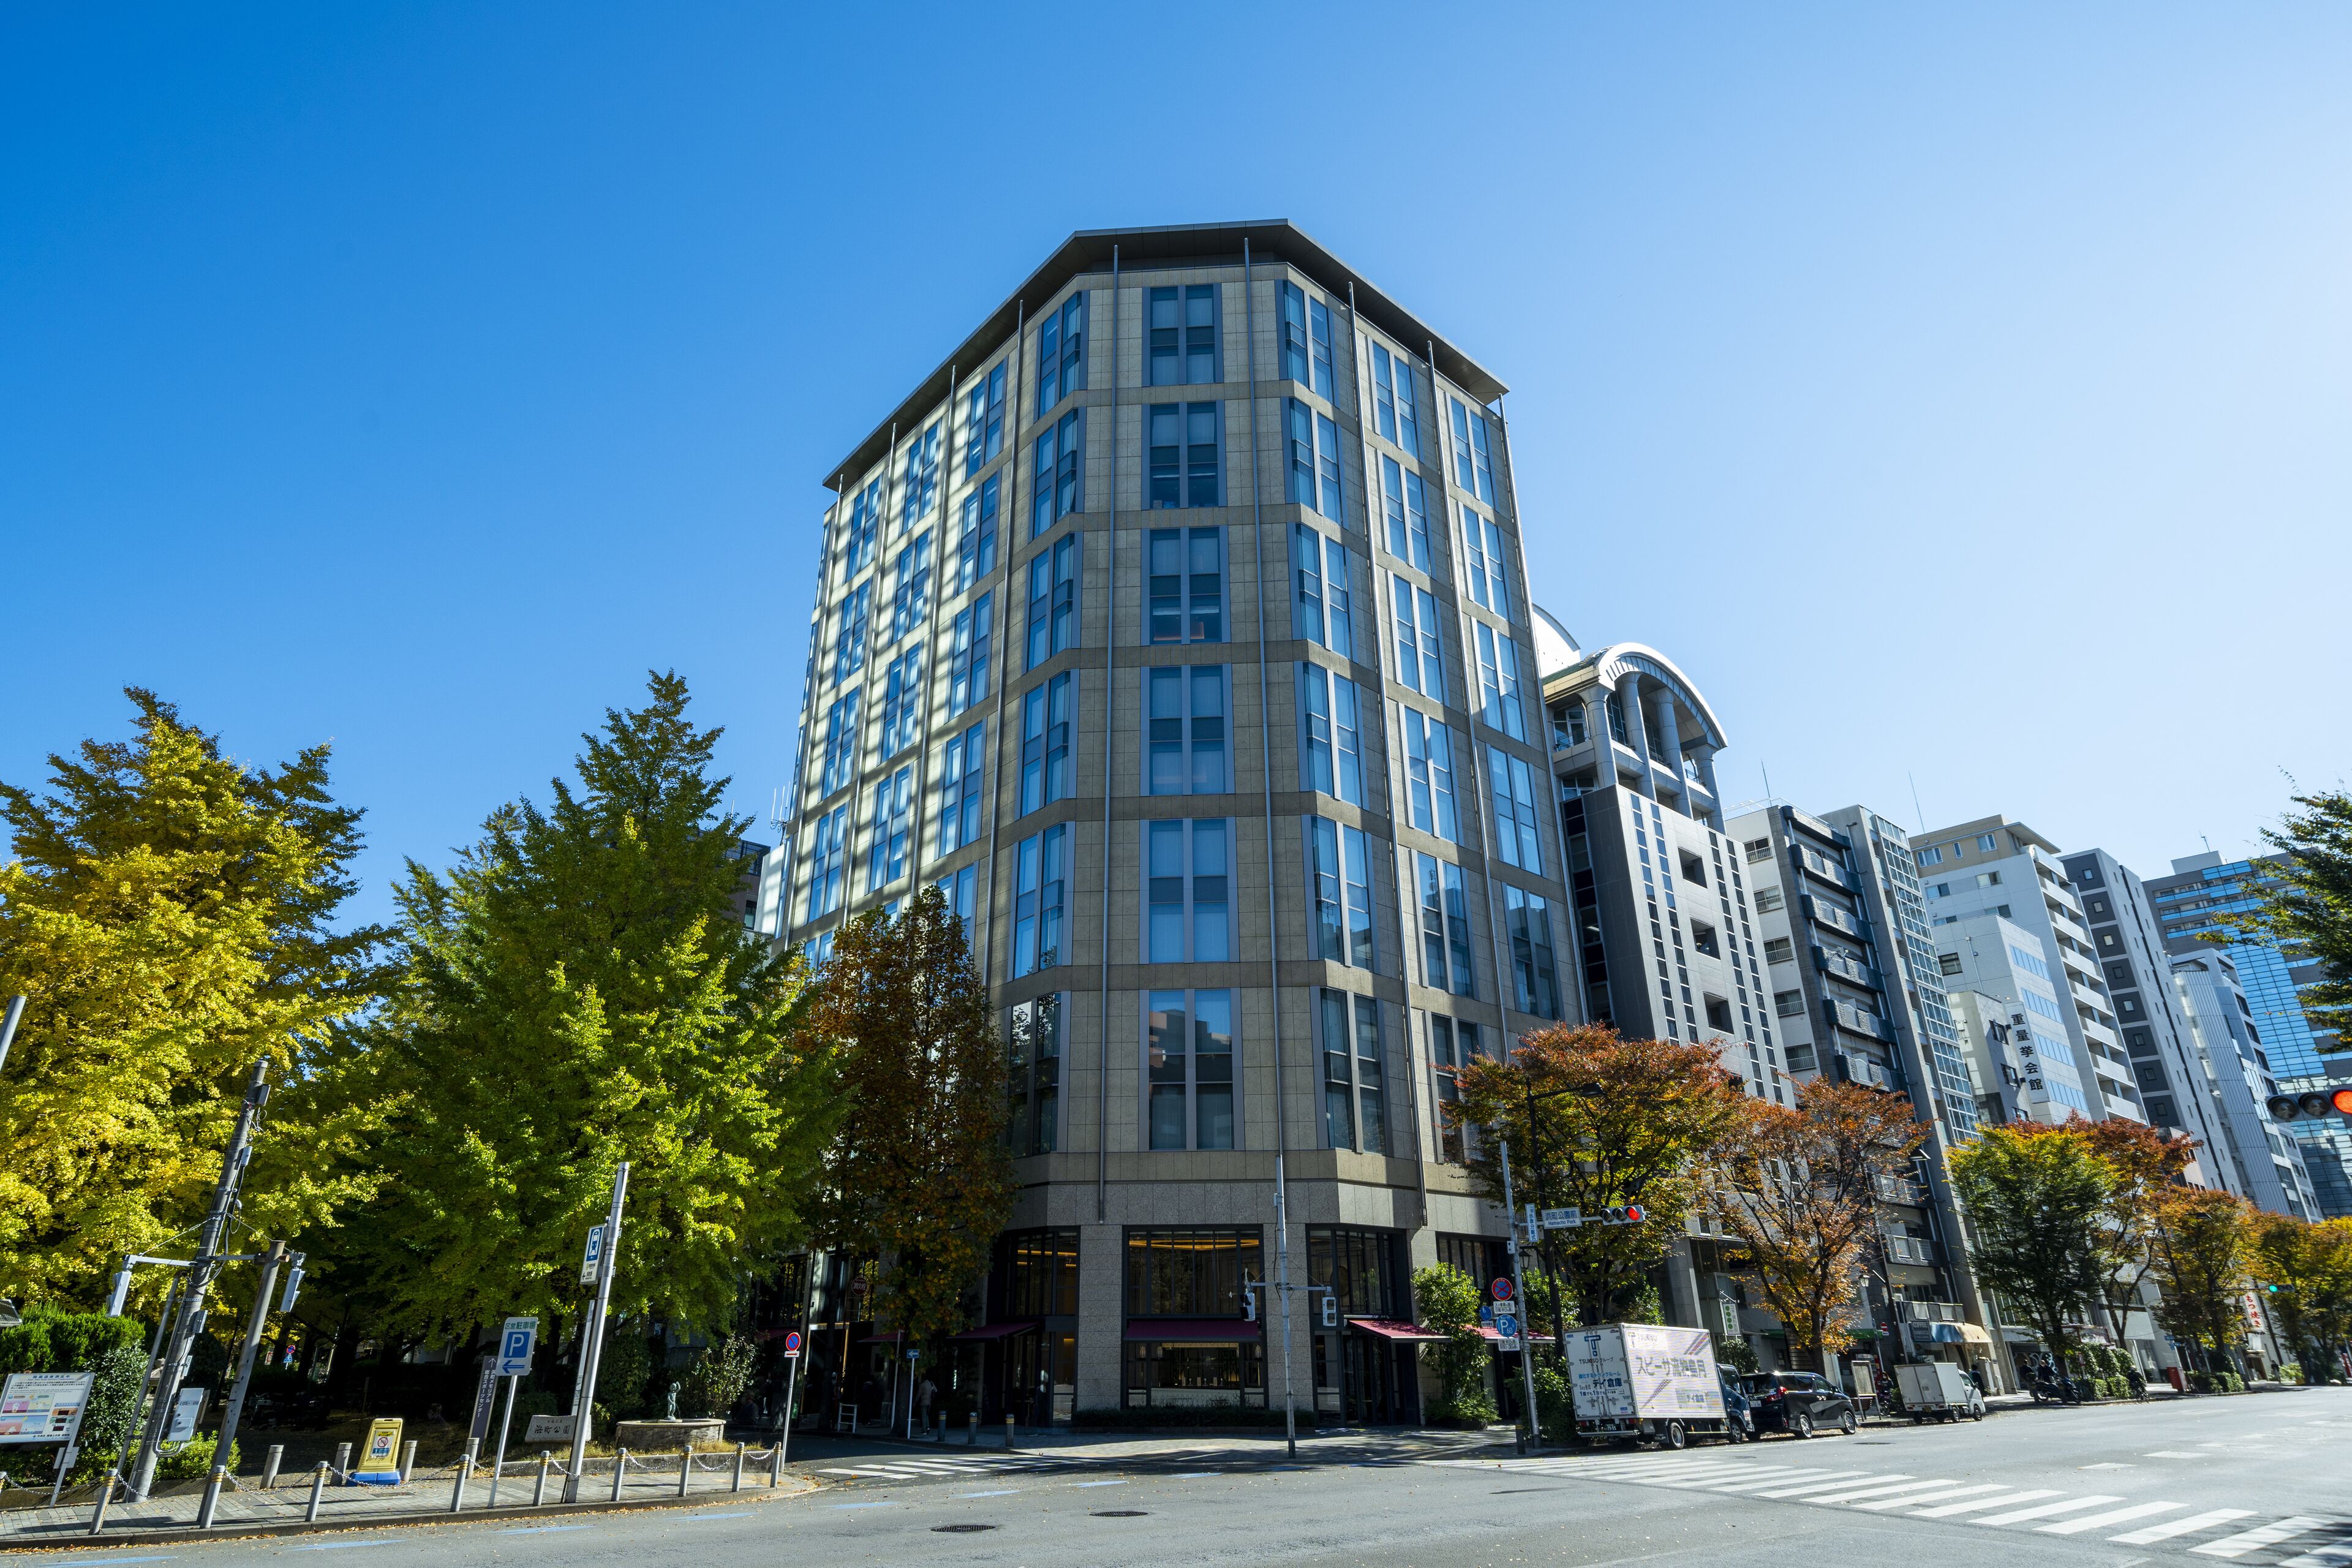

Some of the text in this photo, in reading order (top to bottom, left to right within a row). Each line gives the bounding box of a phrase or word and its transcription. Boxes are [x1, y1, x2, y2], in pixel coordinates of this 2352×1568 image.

[2011, 1013, 2043, 1090] 重量挙会館
[1545, 1210, 1577, 1221] 浜町公園前
[2245, 1295, 2261, 1327] もつ焼き
[505, 1321, 537, 1330] 区営駐車場
[1500, 1320, 1508, 1334] P
[509, 1334, 524, 1357] P
[477, 1370, 490, 1418] 総合スポーツセンター
[535, 1425, 571, 1434] 浜町公園
